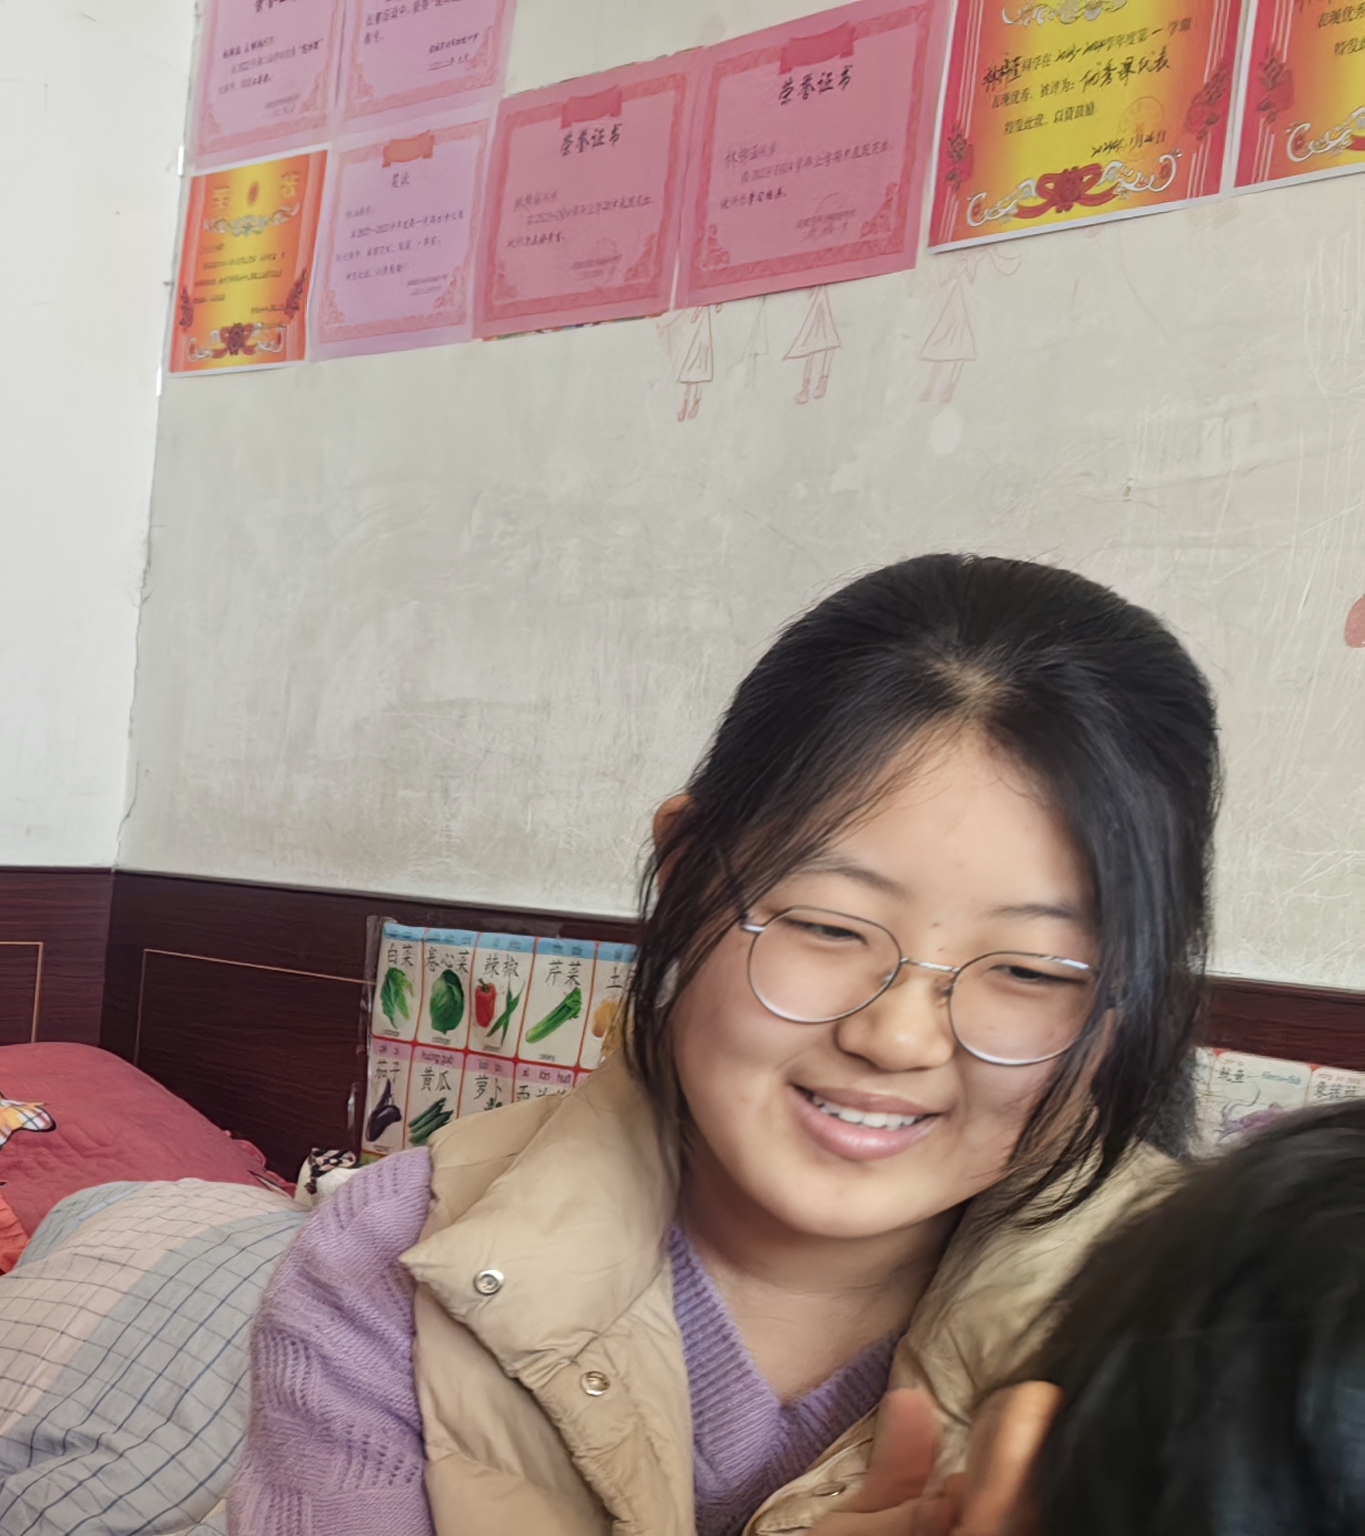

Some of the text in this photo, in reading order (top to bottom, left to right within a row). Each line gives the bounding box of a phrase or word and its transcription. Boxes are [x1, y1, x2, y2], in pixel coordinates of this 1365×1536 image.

[387, 942, 414, 967] 白菜
[545, 960, 582, 986] 芹菜
[419, 1066, 452, 1093] 黄瓜
[473, 1074, 503, 1103] 萝卜
